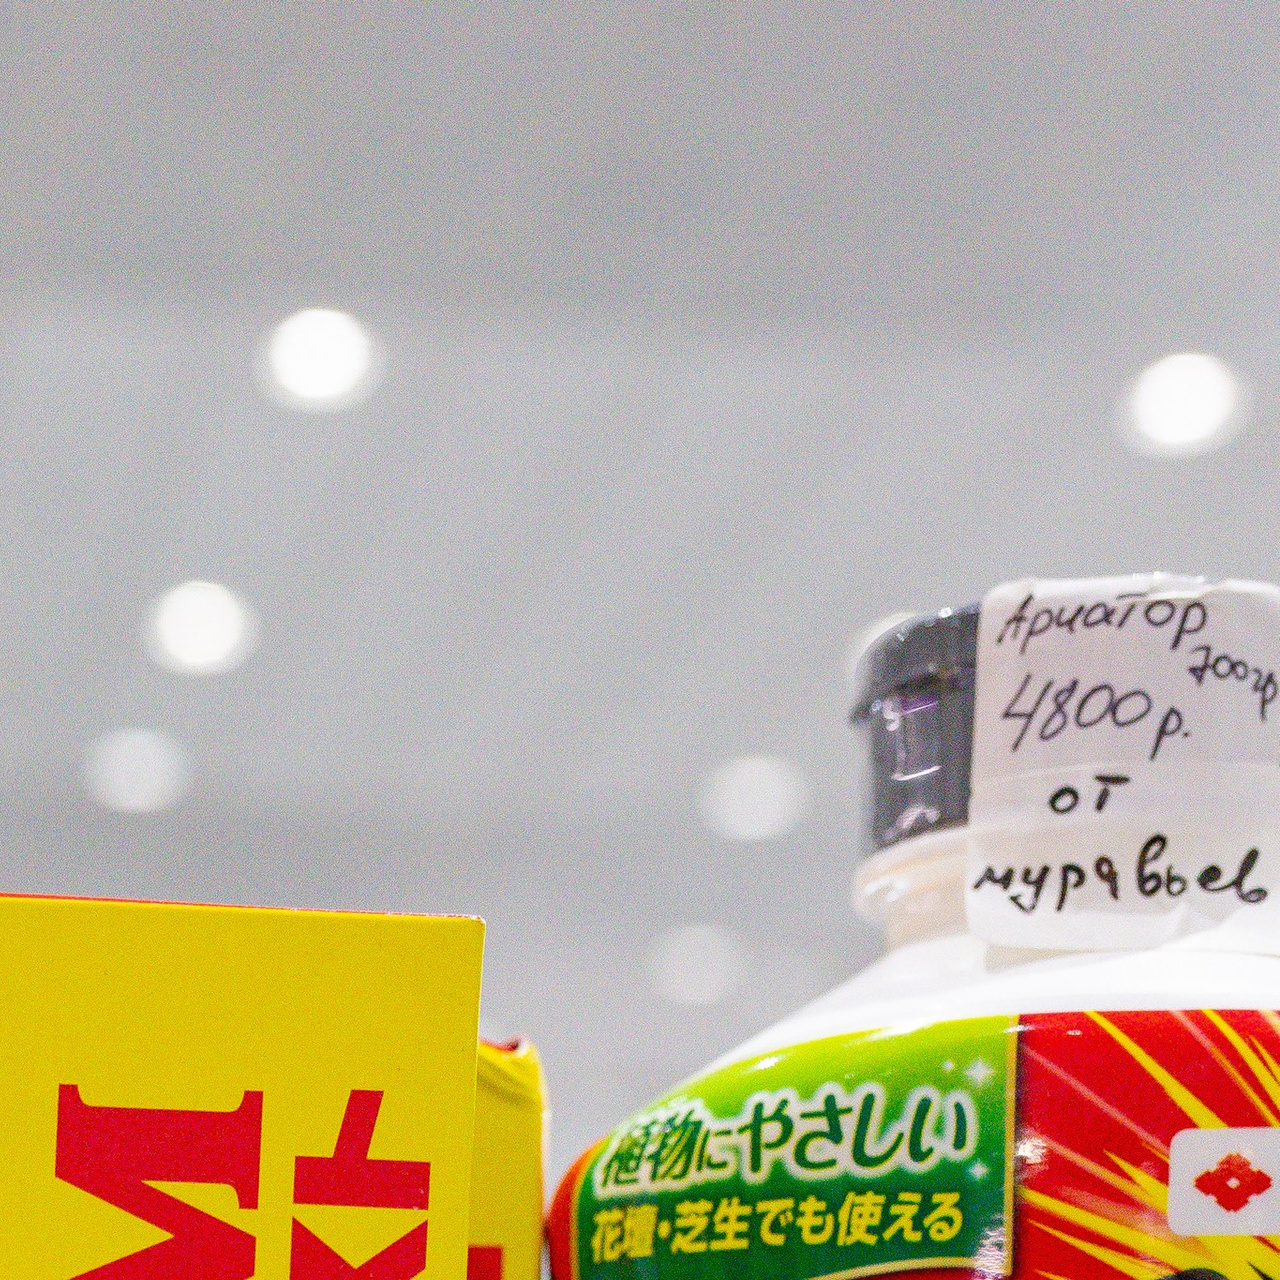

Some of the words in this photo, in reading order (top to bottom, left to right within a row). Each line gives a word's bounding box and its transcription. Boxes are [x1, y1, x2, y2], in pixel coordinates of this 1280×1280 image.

[1000, 674, 1152, 752] 4800
[1150, 706, 1191, 760] р.
[1049, 774, 1131, 813] от
